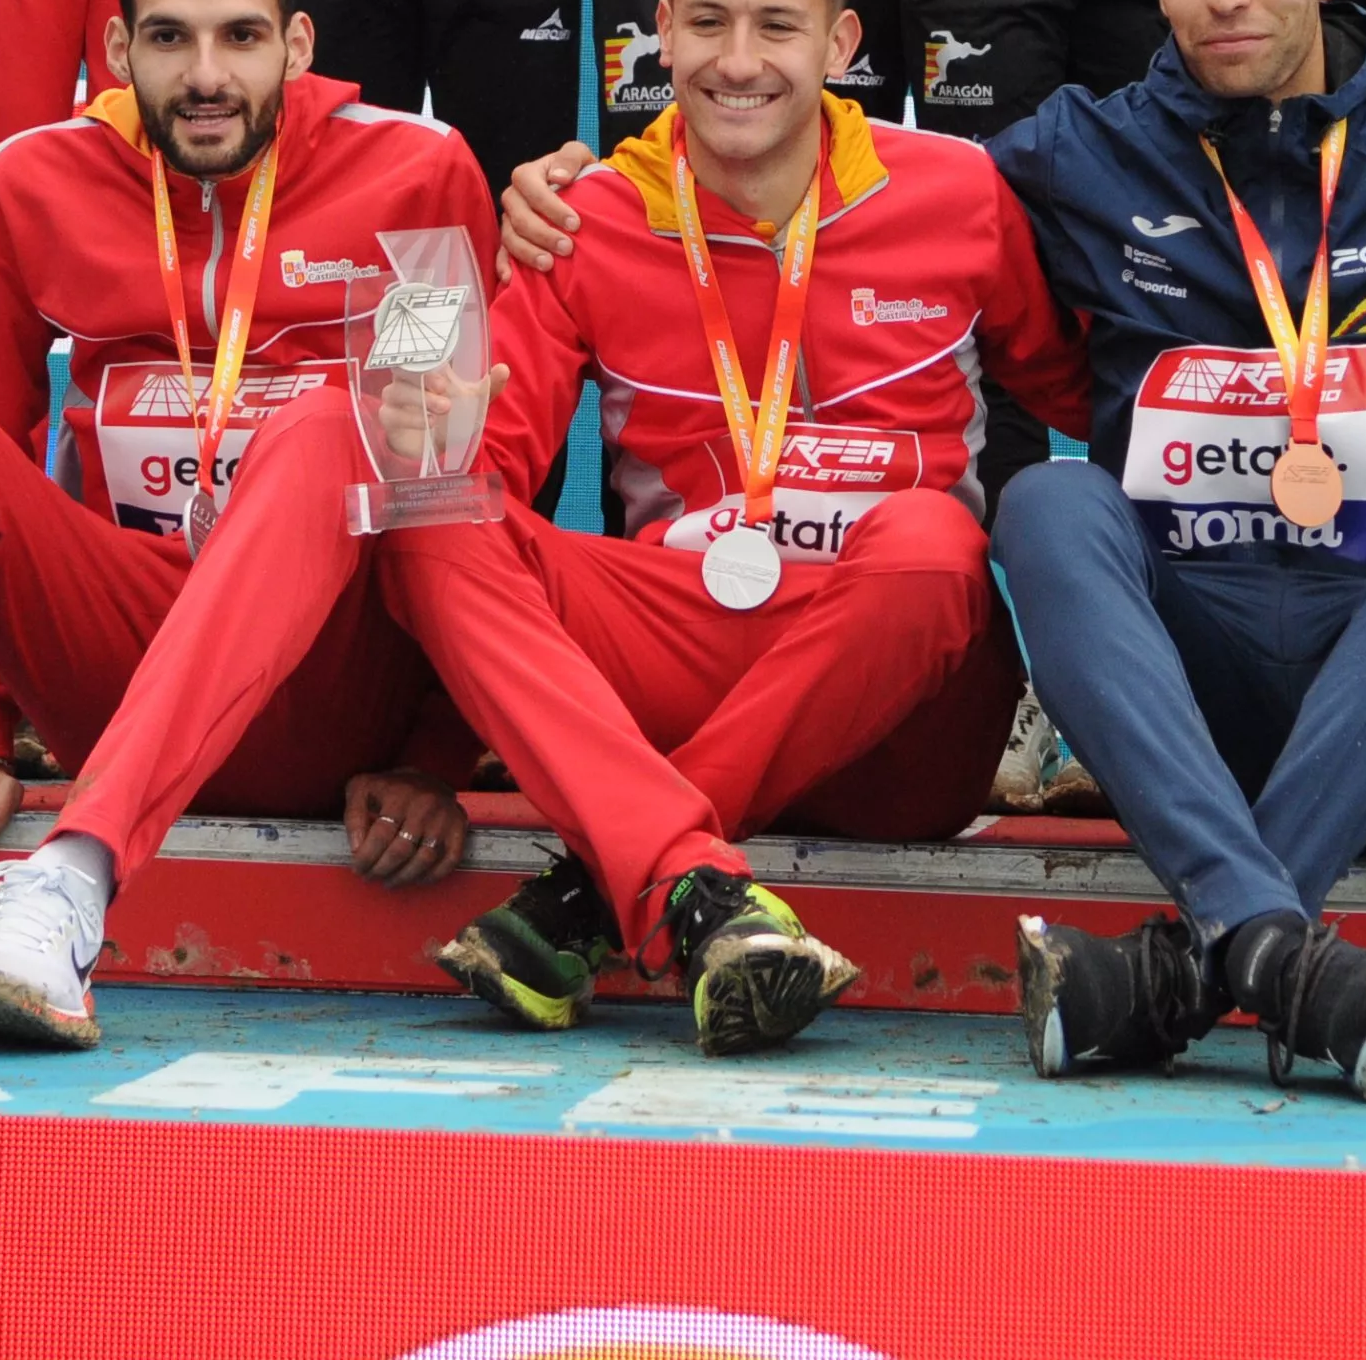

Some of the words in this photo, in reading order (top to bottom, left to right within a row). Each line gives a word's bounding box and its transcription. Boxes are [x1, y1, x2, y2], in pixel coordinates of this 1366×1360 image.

[621, 83, 675, 101] ARAGÓ
[938, 83, 993, 97] ARAGÓN
[675, 155, 697, 240] ATLETISMO
[306, 260, 337, 273] Junta
[338, 259, 352, 270] de
[690, 242, 709, 287] RFEA
[789, 240, 806, 287] RFEA
[1134, 278, 1187, 298] esportcat
[876, 299, 906, 312] Junta
[907, 299, 921, 309] de
[876, 309, 915, 322] Castilla
[923, 306, 947, 318] León
[221, 308, 242, 391] ATLETISMO
[716, 339, 746, 423] ATLETISMO
[758, 429, 775, 475] RFEA
[767, 339, 790, 427] ATLETISMO
